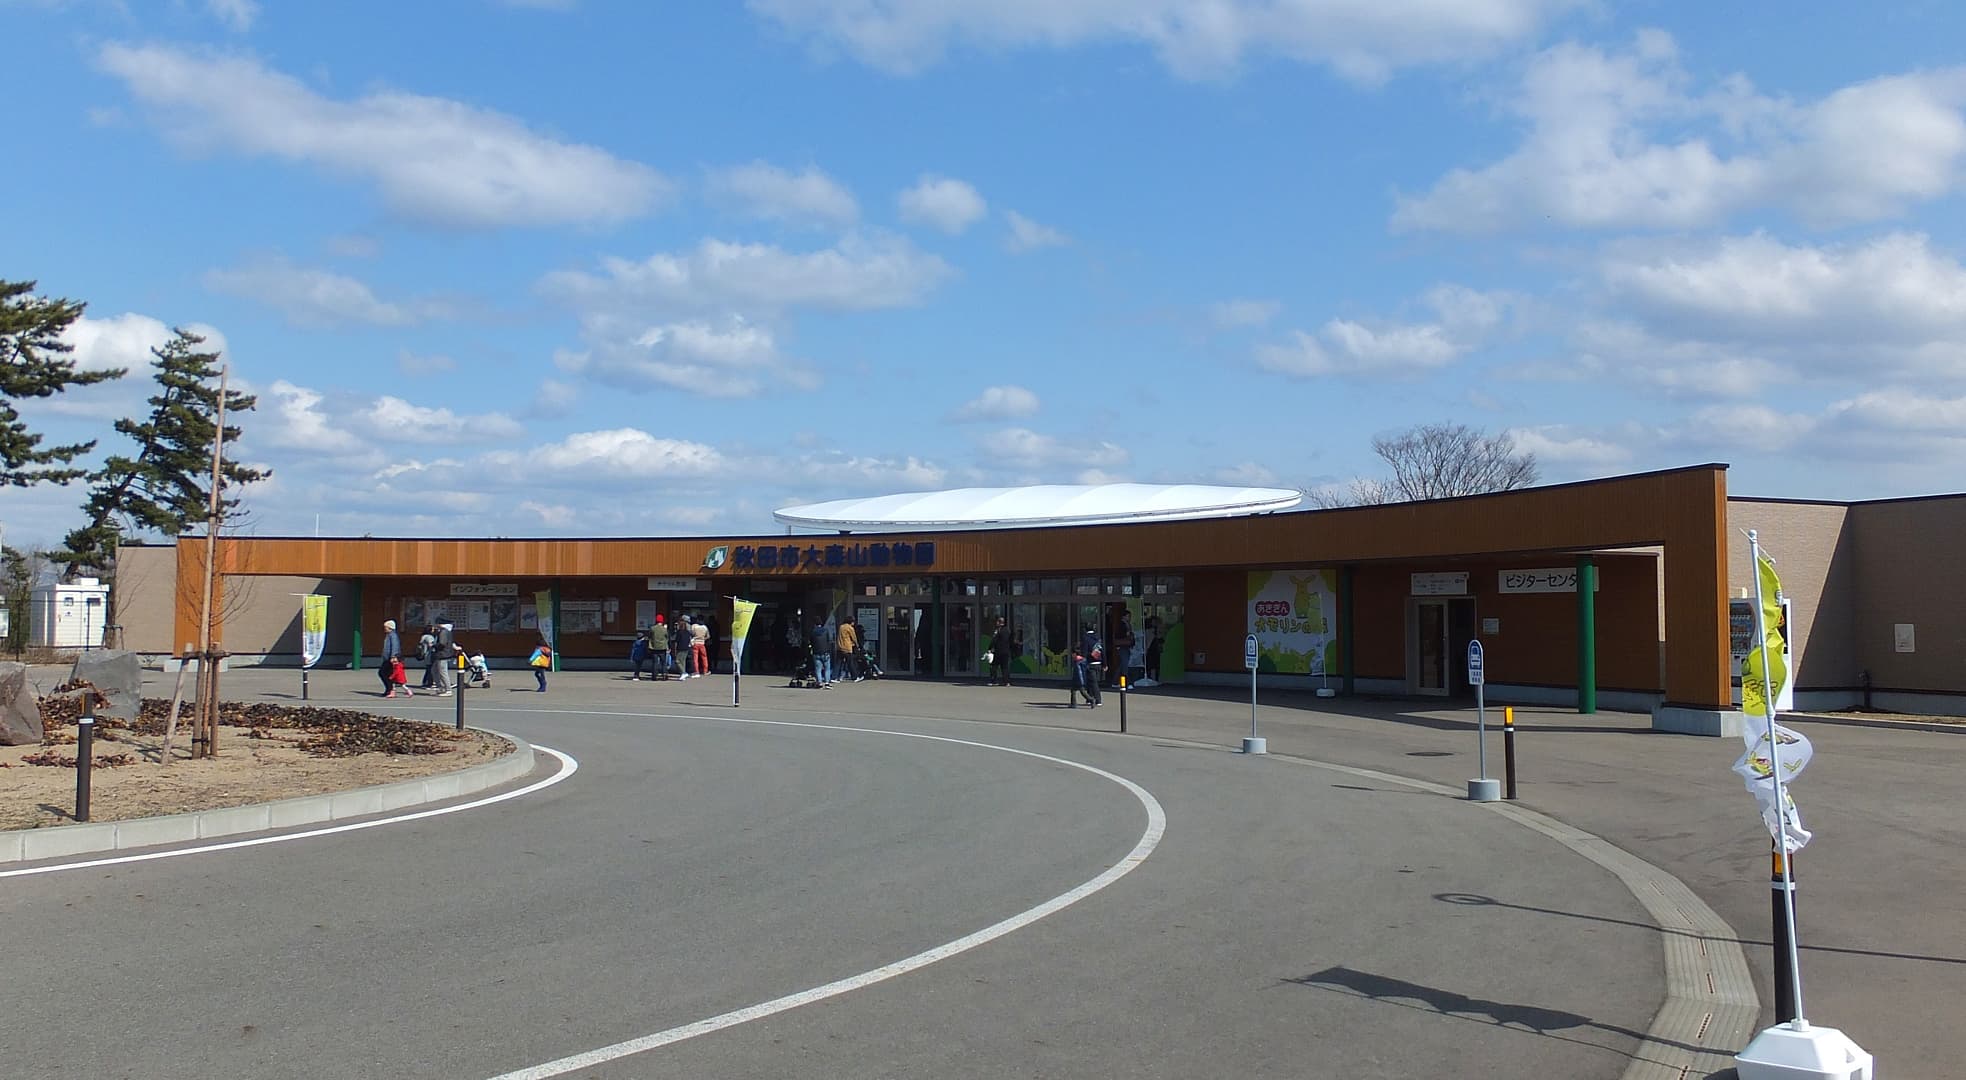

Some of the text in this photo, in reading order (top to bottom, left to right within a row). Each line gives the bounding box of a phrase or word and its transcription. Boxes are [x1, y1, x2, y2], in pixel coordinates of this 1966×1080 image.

[733, 542, 935, 568] 秋田市大森山動物園
[1506, 573, 1578, 588] ビジターセンタ
